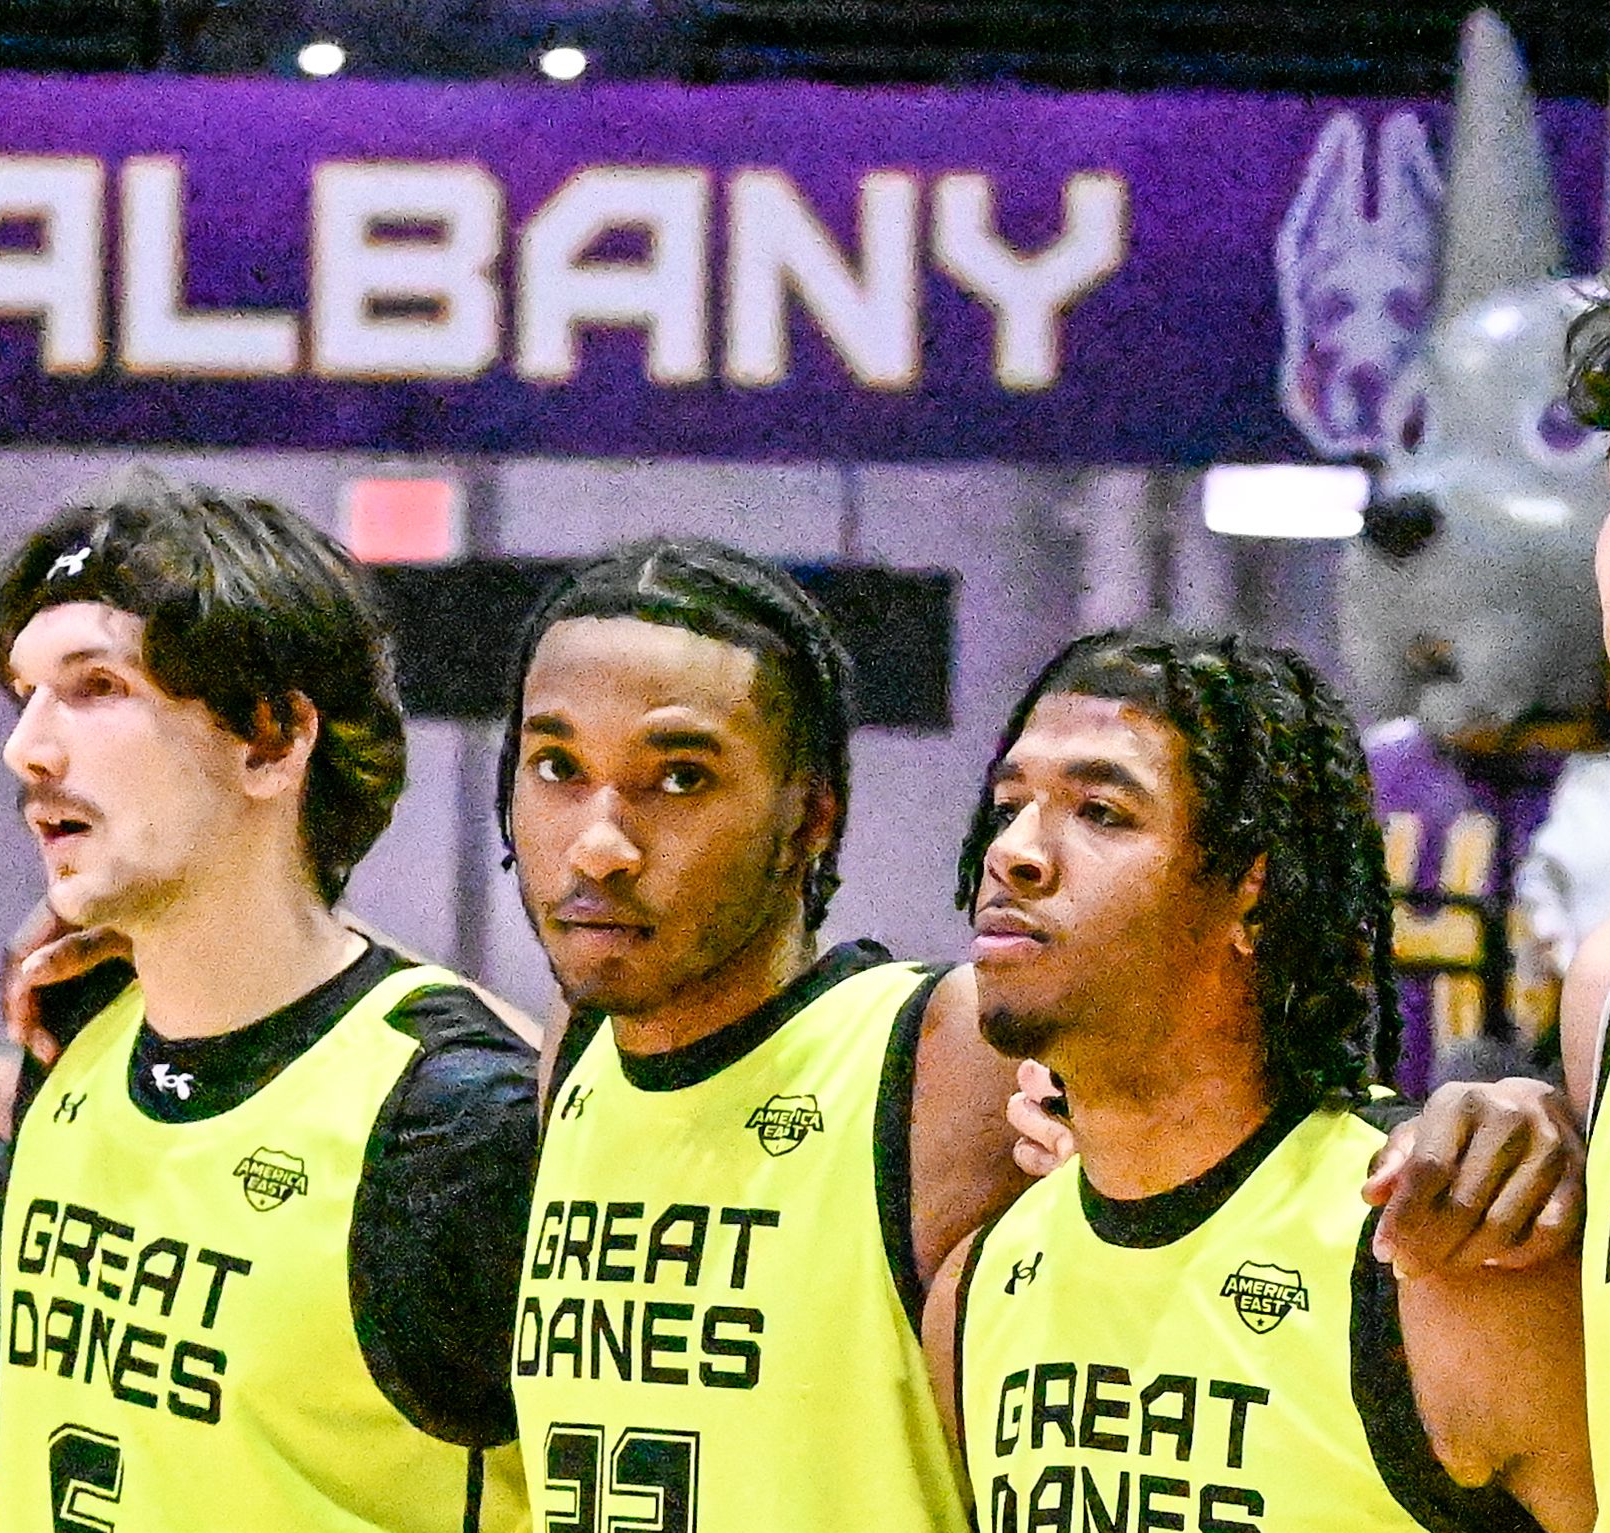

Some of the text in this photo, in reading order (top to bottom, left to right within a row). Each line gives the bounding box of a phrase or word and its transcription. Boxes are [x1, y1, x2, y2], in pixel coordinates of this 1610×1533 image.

[17, 1199, 253, 1330] GREAT
[531, 1199, 781, 1290] GREAT
[1223, 1277, 1308, 1311] AMERICA
[1240, 1295, 1285, 1315] EAST
[8, 1289, 228, 1425] DANES
[516, 1295, 766, 1390] DANES
[995, 1361, 1270, 1469] GREAT
